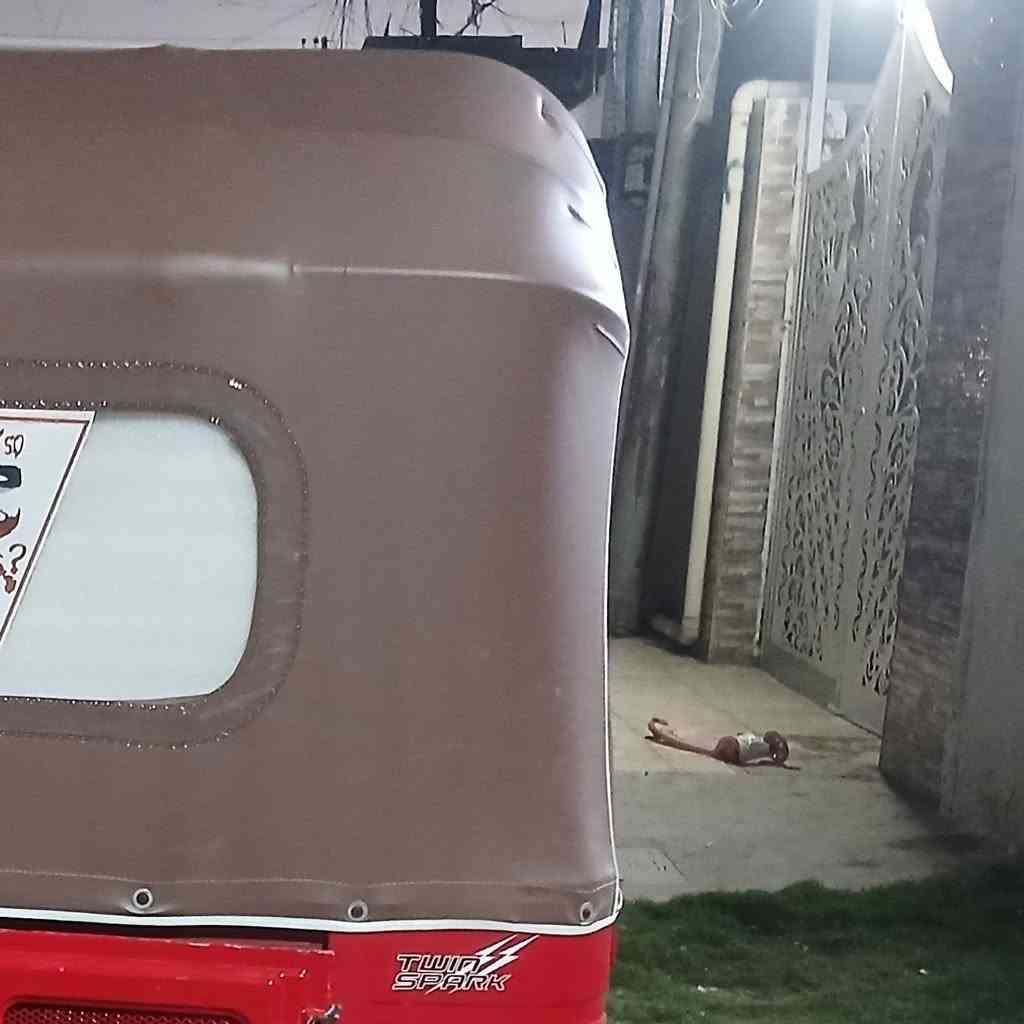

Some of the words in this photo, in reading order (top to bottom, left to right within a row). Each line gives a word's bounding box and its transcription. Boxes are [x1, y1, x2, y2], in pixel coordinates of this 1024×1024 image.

[5, 434, 25, 458] SO
[396, 954, 480, 973] TWIN
[392, 972, 512, 992] SPARK
